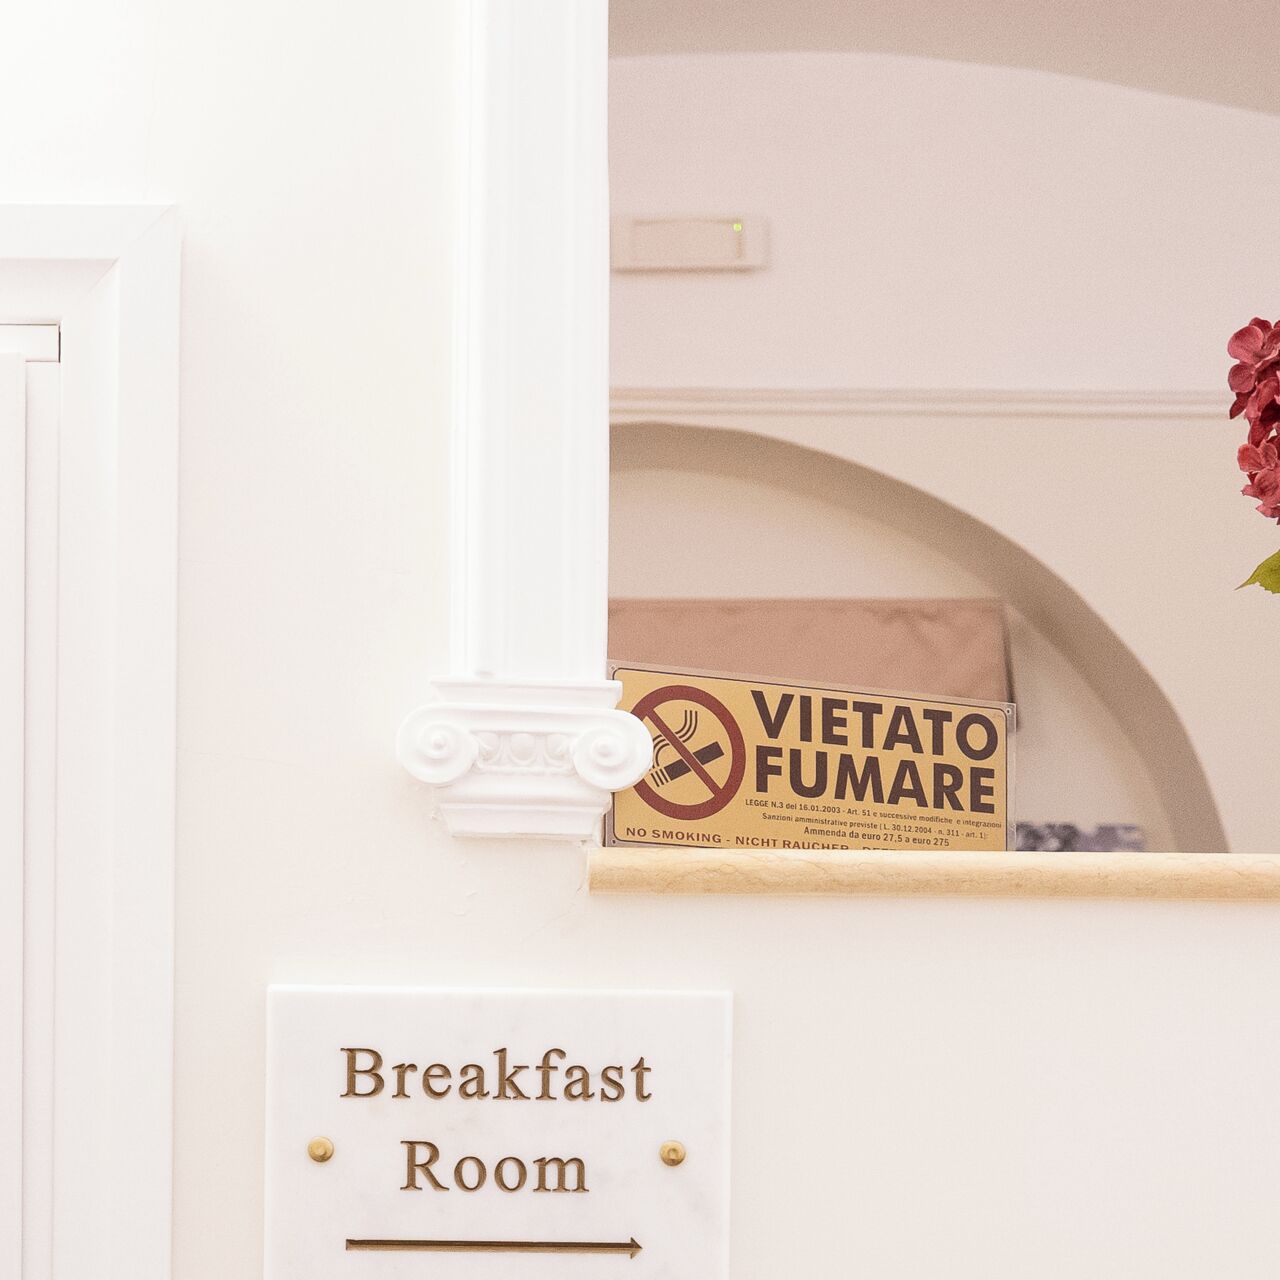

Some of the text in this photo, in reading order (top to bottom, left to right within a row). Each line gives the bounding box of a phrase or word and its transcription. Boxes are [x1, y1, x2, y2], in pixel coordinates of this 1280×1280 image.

[750, 689, 999, 761] VIETATO
[755, 744, 996, 814] FUMARE
[745, 799, 768, 808] LEGGE
[799, 804, 840, 814] 16.01.2003
[880, 812, 918, 820] successive
[919, 816, 952, 824] modifiche
[963, 820, 1002, 828] integrazioni
[762, 812, 793, 822] Sanzioni
[795, 816, 848, 826] amministrative
[850, 820, 878, 829] previste
[892, 824, 932, 834] 30.12.2004
[626, 827, 646, 838] NO
[652, 830, 722, 843] SMOKING
[735, 836, 778, 847] NICHT
[804, 826, 846, 838] Ammenda
[848, 829, 860, 838] da
[862, 832, 881, 840] euro
[883, 833, 902, 843] 27,5
[933, 838, 950, 846] 275
[339, 1046, 654, 1103] Breakfast
[399, 1139, 590, 1194] Room
